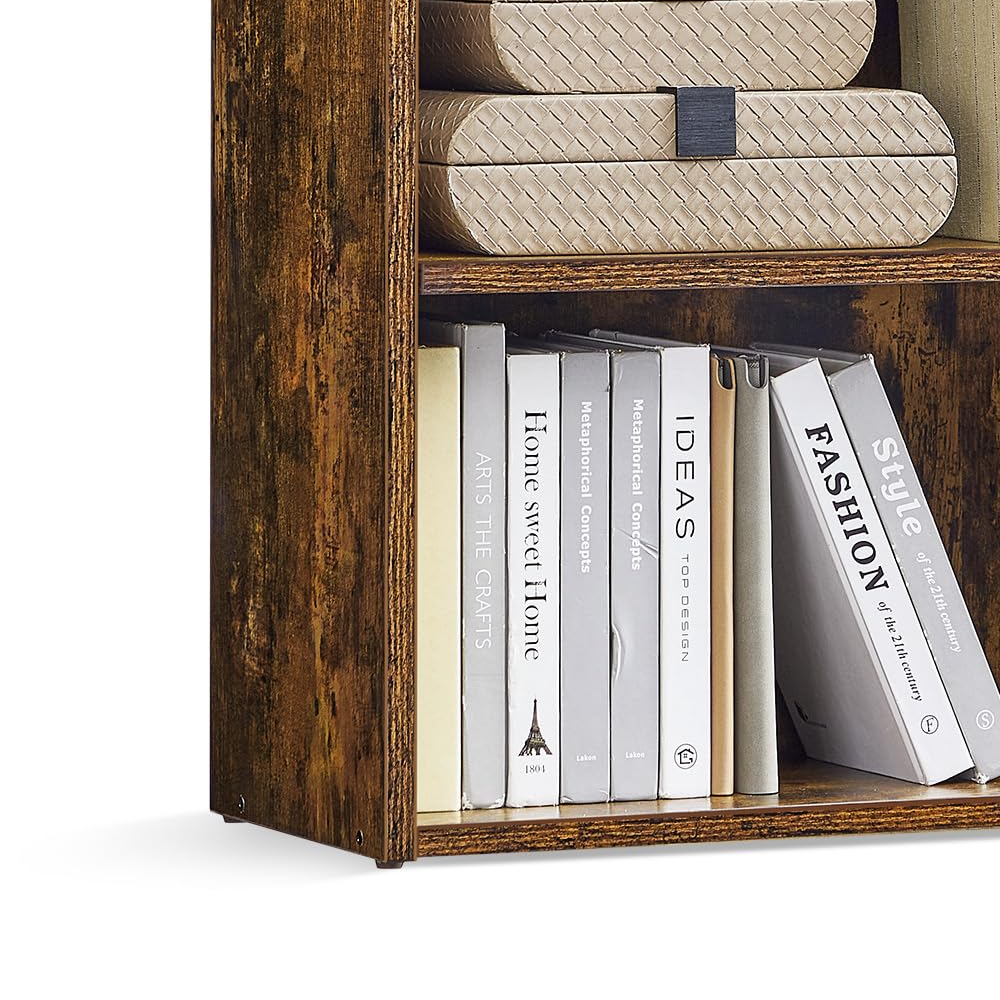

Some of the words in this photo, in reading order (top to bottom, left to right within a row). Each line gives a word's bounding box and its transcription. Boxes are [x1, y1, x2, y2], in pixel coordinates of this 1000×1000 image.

[524, 410, 547, 492] Home
[579, 401, 593, 498] Metaphorical
[631, 399, 644, 496] Metaphorical
[675, 416, 695, 539] IDEAS
[475, 452, 492, 505] ARTS
[805, 423, 889, 591] FASHION
[871, 437, 922, 537] Style
[475, 516, 492, 558] THE
[524, 501, 542, 570] sweet
[579, 505, 592, 574] Concepts
[630, 502, 643, 571] Concepts
[916, 552, 931, 567] of
[681, 554, 690, 588] TOP
[923, 567, 936, 585] the
[930, 586, 947, 611] 21th
[475, 569, 492, 649] CRAFTS
[524, 578, 547, 661] Home
[681, 595, 690, 662] DESIGN
[877, 601, 892, 614] of
[884, 616, 896, 634] the
[940, 612, 961, 653] century
[892, 635, 908, 659] 21th
[902, 661, 922, 702] century
[525, 765, 546, 774] 1804
